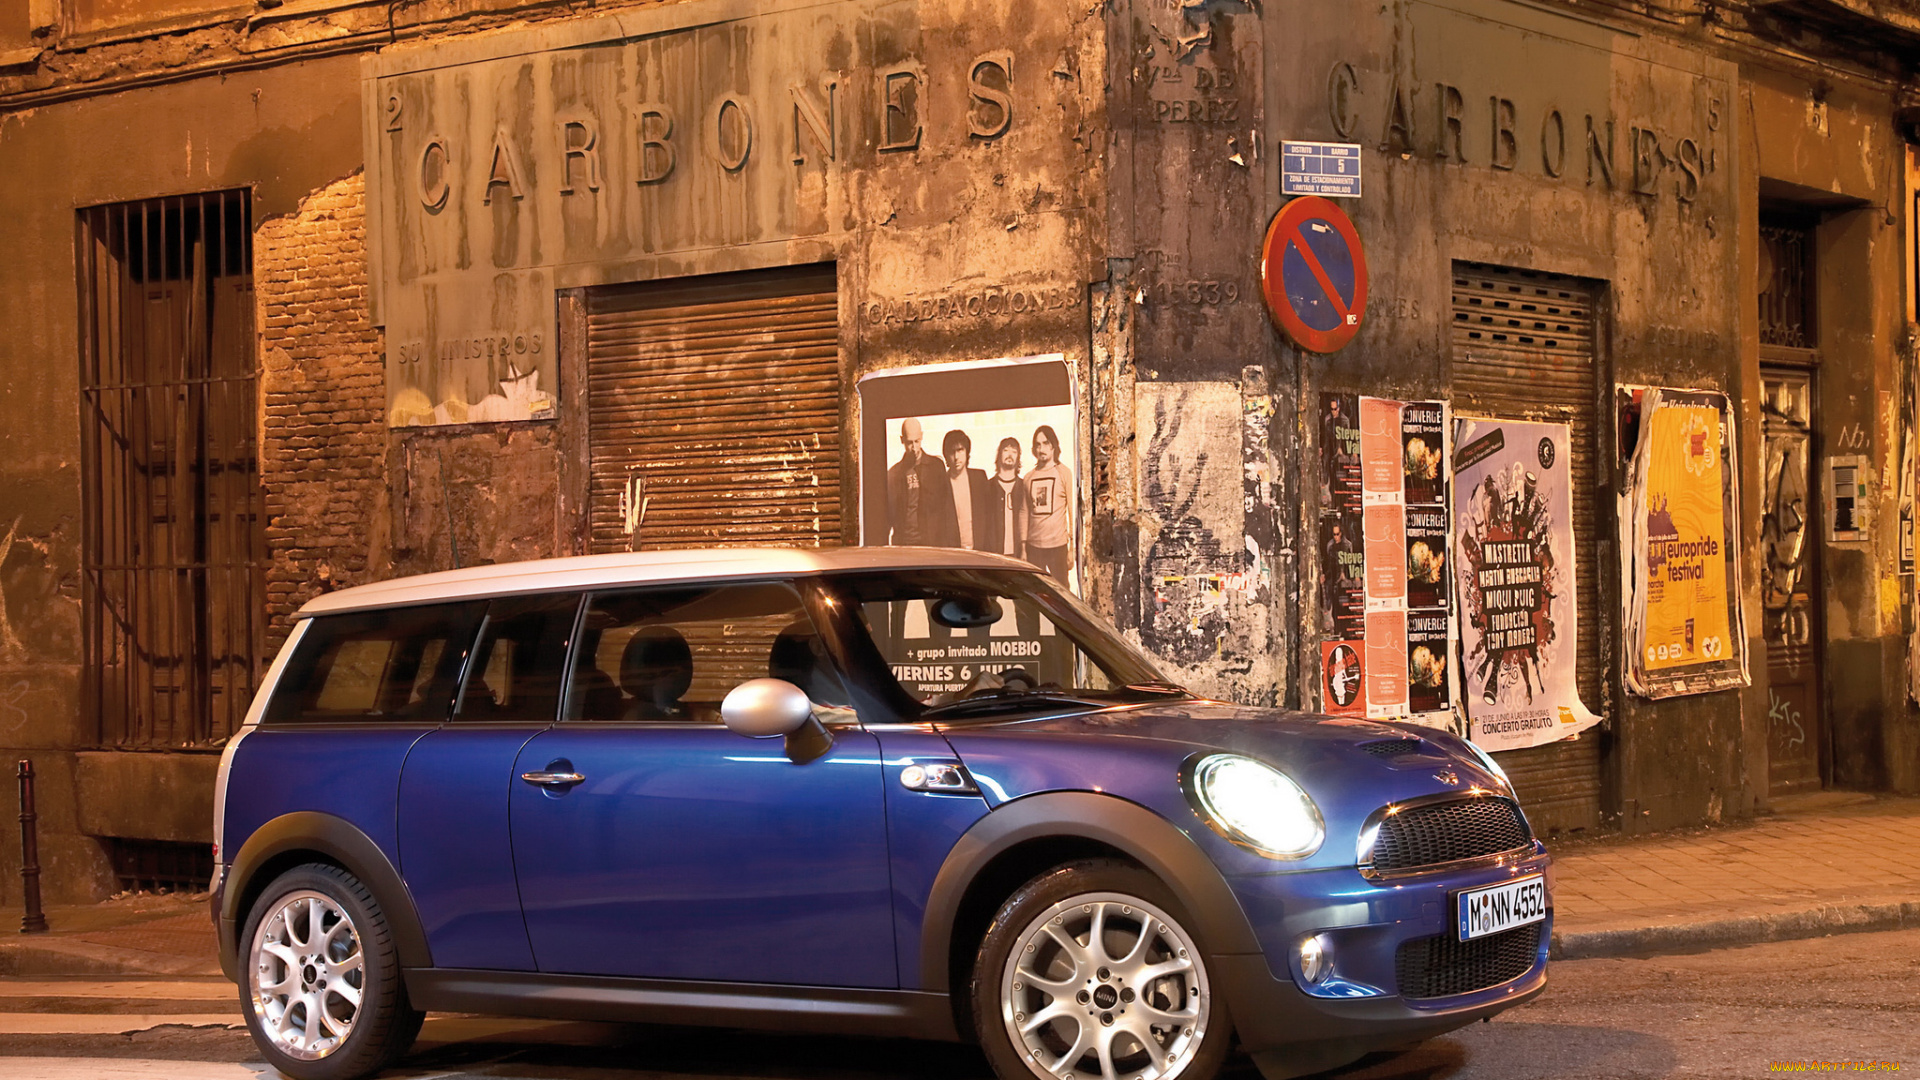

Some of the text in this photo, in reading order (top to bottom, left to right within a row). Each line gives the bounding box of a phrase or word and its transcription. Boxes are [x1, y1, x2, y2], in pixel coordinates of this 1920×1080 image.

[1194, 66, 1235, 90] DE
[1153, 100, 1239, 124] PEREZ
[416, 52, 1015, 212] CARBONES
[1328, 61, 1699, 202] CARBONES
[1291, 146, 1312, 154] DISTRITO
[1331, 147, 1348, 156] BARRIO
[1300, 156, 1305, 171] 1
[1338, 159, 1345, 173] 5
[1289, 175, 1302, 183] ZONA
[1311, 177, 1354, 185] ESTACIONAMIENTO
[1293, 184, 1315, 192] LIMITADO
[1321, 185, 1351, 193] CONTROLADO
[1335, 425, 1360, 440] Steve
[1406, 513, 1444, 527] CONVERGE
[1485, 543, 1531, 563] MASTRETTA
[1667, 535, 1718, 562] europride
[1338, 550, 1362, 565] Steve
[1349, 565, 1363, 578] Vai
[1667, 559, 1704, 582] festival
[1486, 588, 1534, 610] MIQUI PUIG
[1408, 617, 1446, 631] CONVERGE
[917, 648, 945, 662] grupo
[947, 645, 988, 657] invitado
[990, 641, 1041, 656] MOEBIO
[891, 665, 954, 682] VIERNES
[960, 665, 971, 680] 6
[918, 683, 943, 692] APERTURA
[1482, 720, 1519, 735] CONCIERTO
[1520, 717, 1553, 730] GRATUITO
[1470, 882, 1544, 932] M NN 4552
